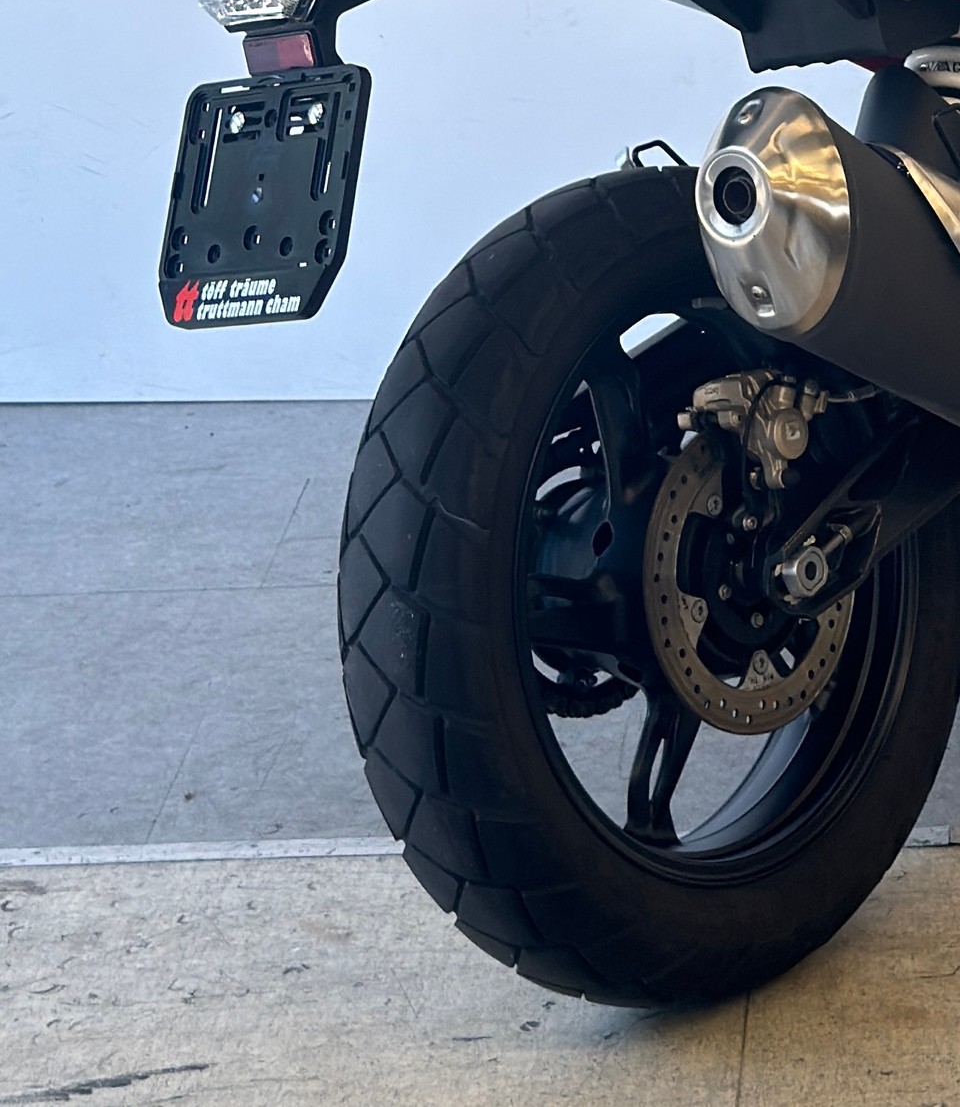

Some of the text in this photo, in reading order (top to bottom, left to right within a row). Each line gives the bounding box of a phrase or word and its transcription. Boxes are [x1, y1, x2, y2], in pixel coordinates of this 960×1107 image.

[201, 278, 277, 301] töff träume
[196, 294, 301, 321] truttmann cham
